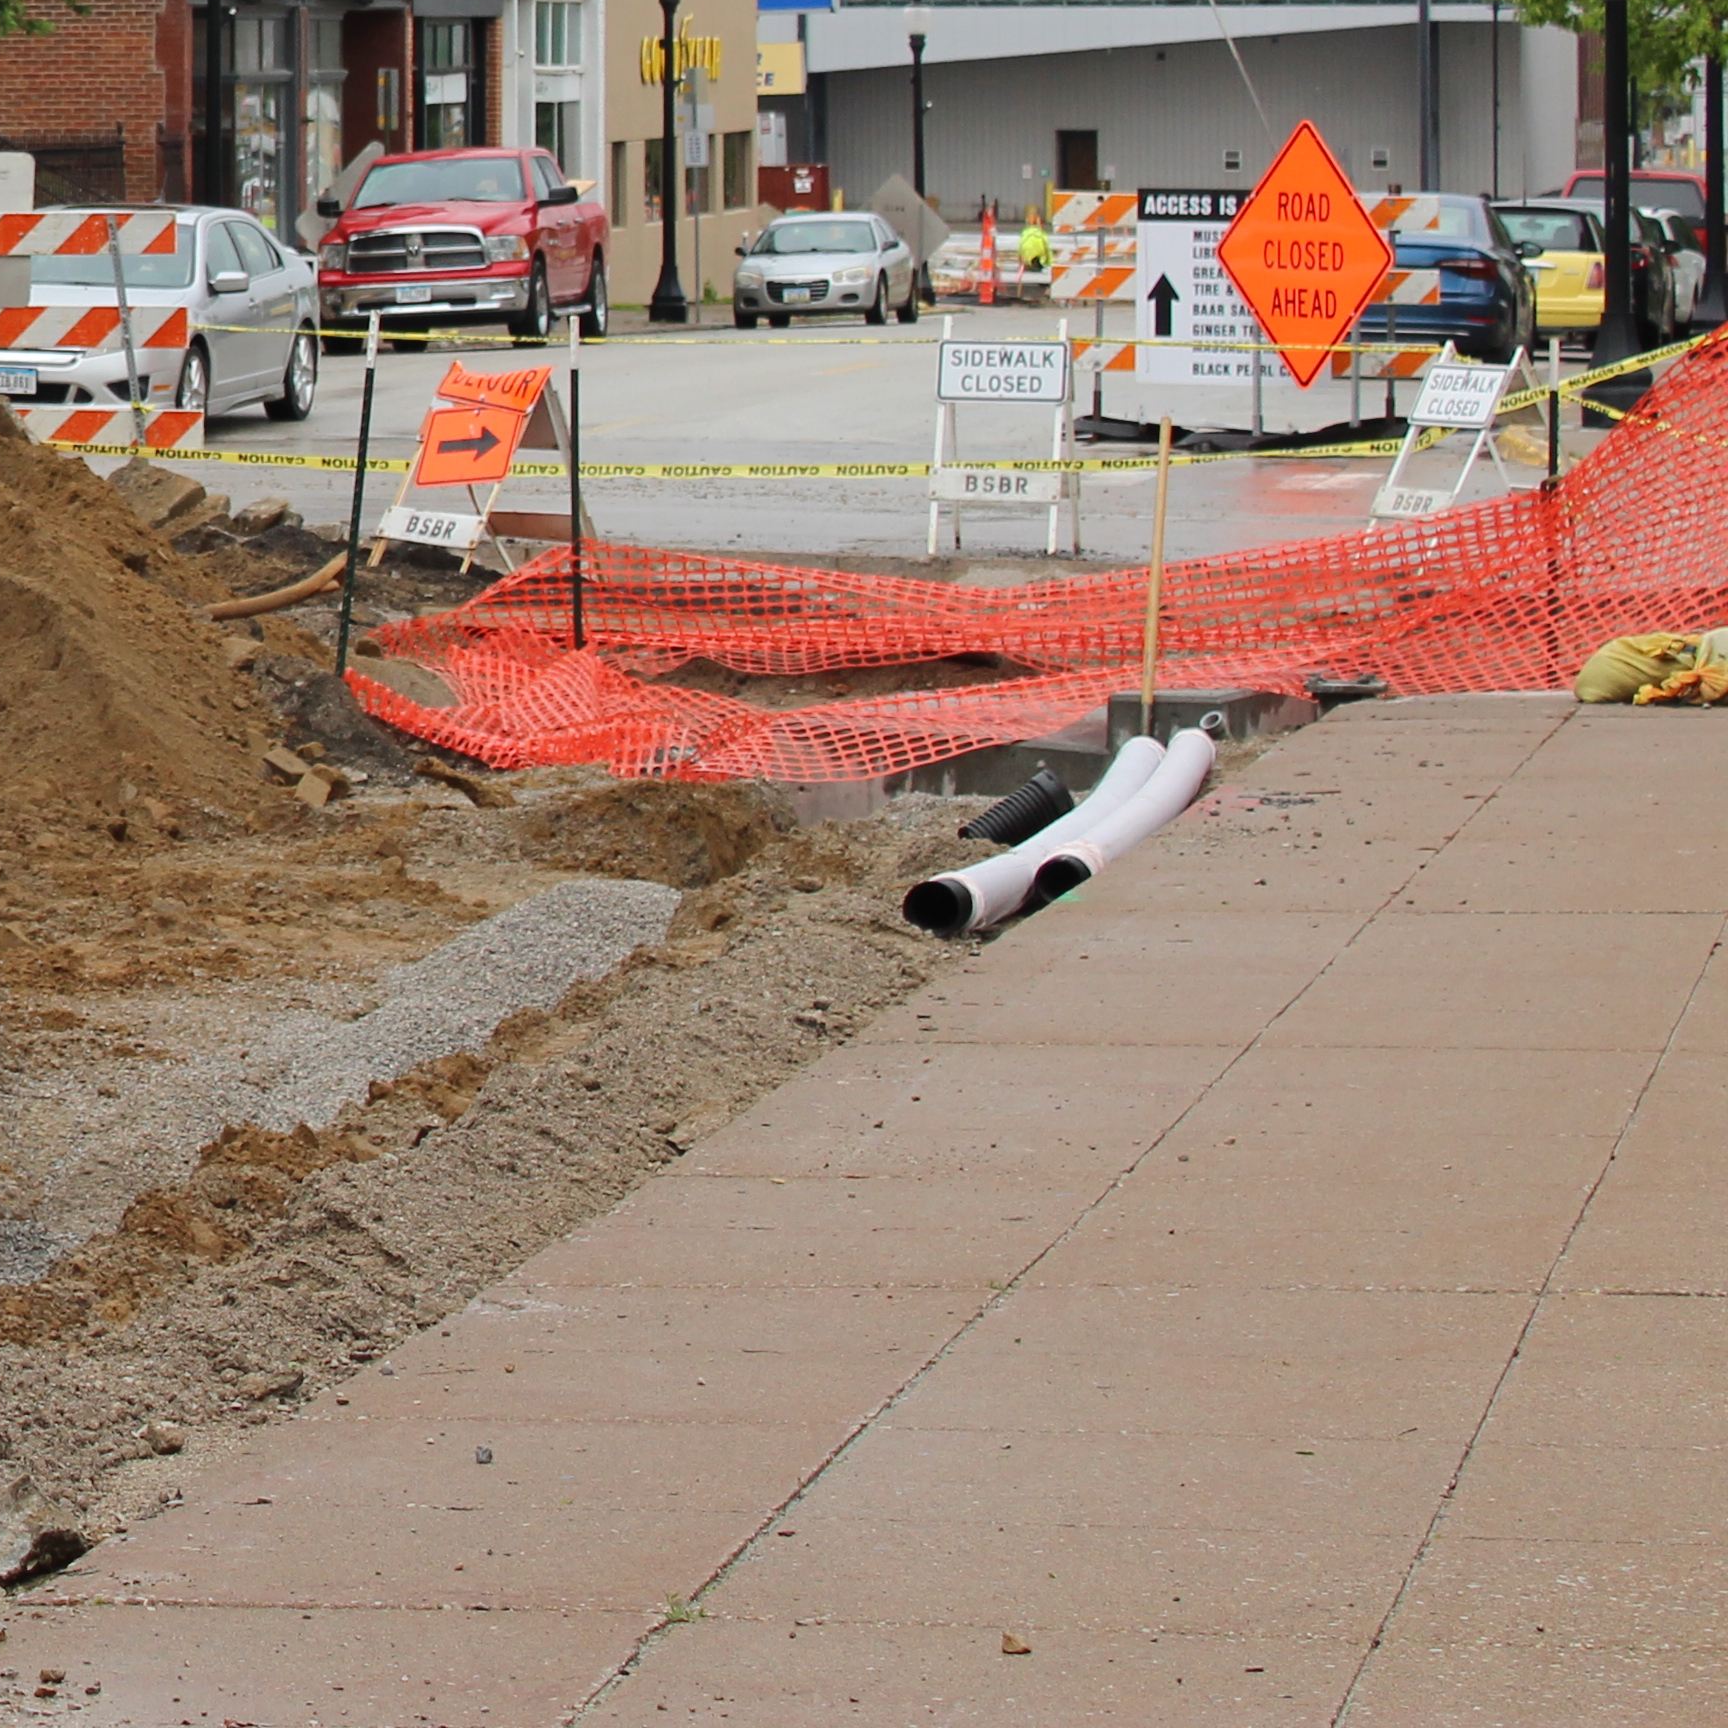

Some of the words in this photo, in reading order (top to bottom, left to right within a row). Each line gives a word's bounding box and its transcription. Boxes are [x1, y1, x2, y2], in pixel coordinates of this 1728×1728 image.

[1144, 194, 1212, 216] ACCESS
[1219, 195, 1237, 216] IS
[1278, 192, 1330, 222] ROAD
[1263, 240, 1344, 272] CLOSED
[1193, 268, 1228, 279] GREA
[1194, 284, 1219, 296] TIRE
[1271, 288, 1337, 319] AHEAD
[1193, 305, 1224, 317] BAAR
[1193, 325, 1236, 337] GINGER
[951, 349, 1055, 368] SIDEWALK
[1192, 364, 1231, 376] BLACK
[1236, 365, 1273, 377] PERL
[961, 375, 1042, 393] CLOSED
[1430, 374, 1498, 393] SIDEWALK
[1500, 388, 1547, 409] AUTION
[1427, 399, 1480, 417] CLOSED
[72, 444, 139, 456] CAUTION
[155, 448, 222, 461] CAUTION
[238, 454, 305, 465] CAUTION
[321, 458, 389, 470] CATION
[1013, 460, 1084, 470] CAUTION
[510, 464, 559, 476] CAUTI
[661, 466, 732, 476] CAUTION
[749, 465, 819, 476] CAUTION
[836, 465, 908, 476] CAUTION
[965, 475, 1029, 494] BSBR
[1392, 494, 1433, 513] BSBR
[406, 515, 456, 540] BSBR
